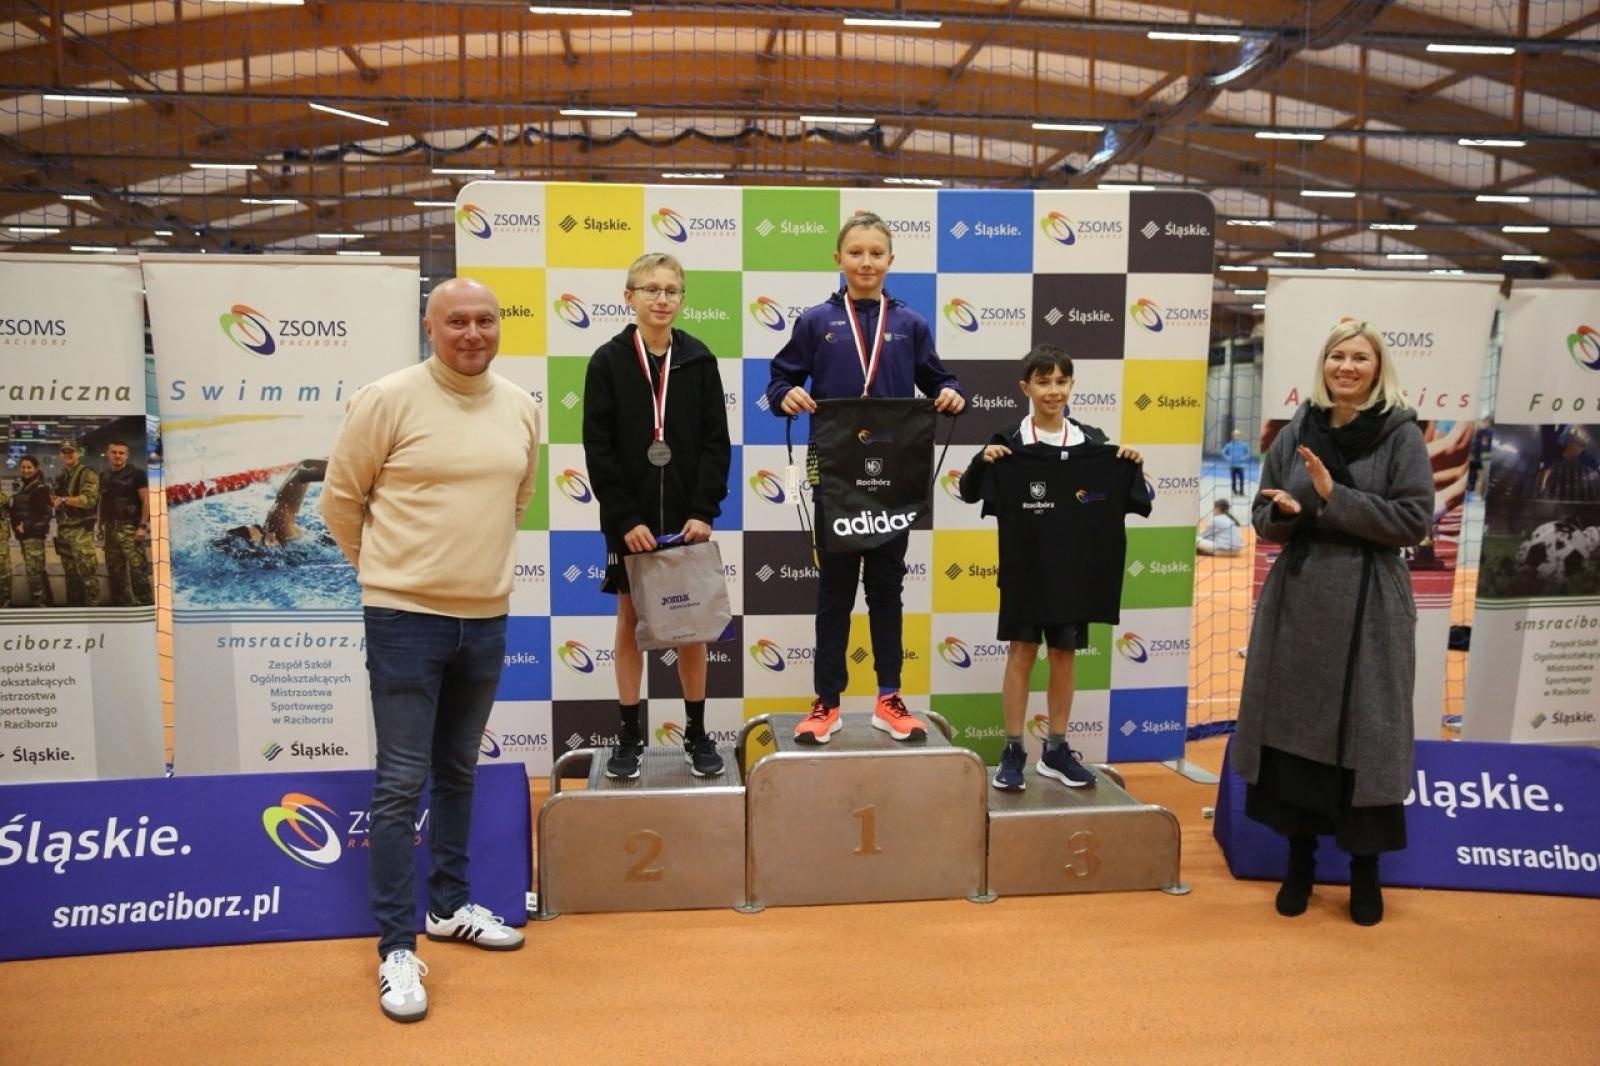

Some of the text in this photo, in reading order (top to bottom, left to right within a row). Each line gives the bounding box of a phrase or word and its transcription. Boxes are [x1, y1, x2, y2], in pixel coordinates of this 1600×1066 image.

[494, 214, 540, 226] ZSOMS
[584, 216, 631, 233] Śląskie.
[690, 218, 736, 230] ZSOMS
[781, 219, 828, 236] Śląskie.
[1078, 221, 1122, 233] ZSOMS
[975, 221, 1021, 238] Śląskie.
[1165, 221, 1210, 238] Śląskie.
[500, 305, 534, 319] ąskie.
[683, 306, 730, 322] Śląskie.
[981, 308, 1026, 319] ZSOMS
[1068, 308, 1114, 325] Śląskie.
[1165, 308, 1209, 320] ZSOMS
[279, 320, 347, 337] ZSOMS
[1381, 332, 1434, 348] SOMS
[170, 379, 361, 401] Swimmi
[972, 393, 1017, 411] Śląskie.
[1073, 394, 1116, 405] ZSOMS
[1158, 395, 1200, 410] Śląskie.
[1528, 393, 1600, 411] Foo
[1158, 477, 1200, 489] ZSOMS
[514, 564, 546, 577] OMS
[780, 564, 820, 581] Śląski
[969, 563, 999, 579] Śląsk
[1150, 560, 1191, 575] Śląskie.
[1514, 614, 1600, 631] smsracibo
[217, 632, 369, 651] smsraciborz.p
[1150, 639, 1190, 651] ZSOMS
[787, 648, 815, 659] ZSO
[974, 645, 1011, 656] ZSOM
[26, 662, 55, 672] Szkół
[268, 660, 332, 671] Zespół Szkół
[504, 652, 539, 667] ąskie.
[270, 688, 332, 697] Mistrzostwa
[271, 702, 333, 713] Sportowego
[4, 720, 58, 729] Raciborzu
[283, 715, 333, 724] Raciborzu
[1068, 721, 1103, 732] SOMS
[1142, 719, 1184, 733] Śląskie.
[1552, 711, 1596, 727] Śląskie.
[503, 734, 548, 746] ZSOMS
[708, 731, 737, 742] OMS
[965, 726, 1005, 739] Śląskie
[13, 746, 75, 765] Śląskie.
[290, 741, 349, 759] Śląskie.
[1405, 770, 1564, 818] ląskie.
[852, 804, 882, 856] 1
[0, 813, 192, 875] Śląskie.
[624, 829, 665, 882] 2
[1064, 830, 1101, 877] 3
[52, 886, 281, 930] smsraciborz.pl
